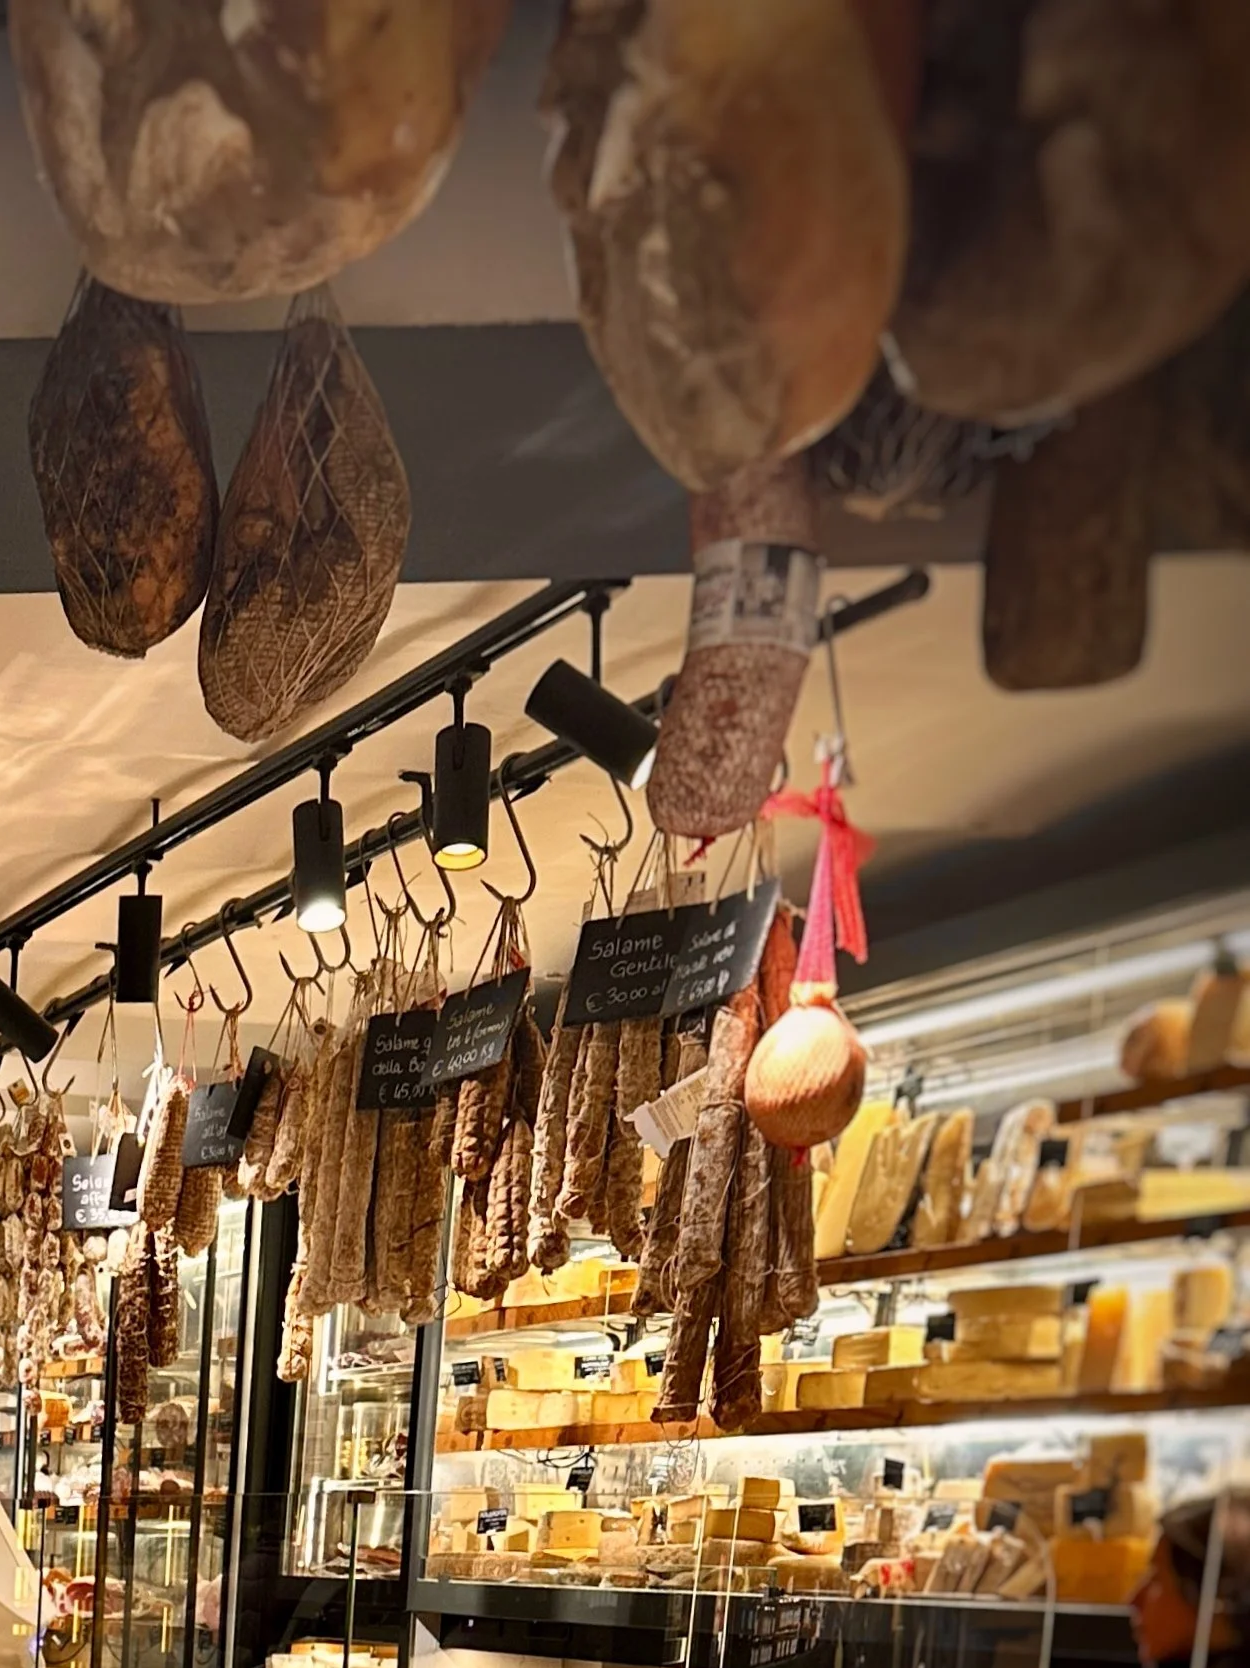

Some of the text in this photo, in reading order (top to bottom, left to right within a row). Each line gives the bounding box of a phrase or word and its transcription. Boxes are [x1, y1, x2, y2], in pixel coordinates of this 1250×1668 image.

[588, 933, 664, 961] Salame
[374, 1033, 420, 1056] Salame
[372, 1058, 403, 1076] della
